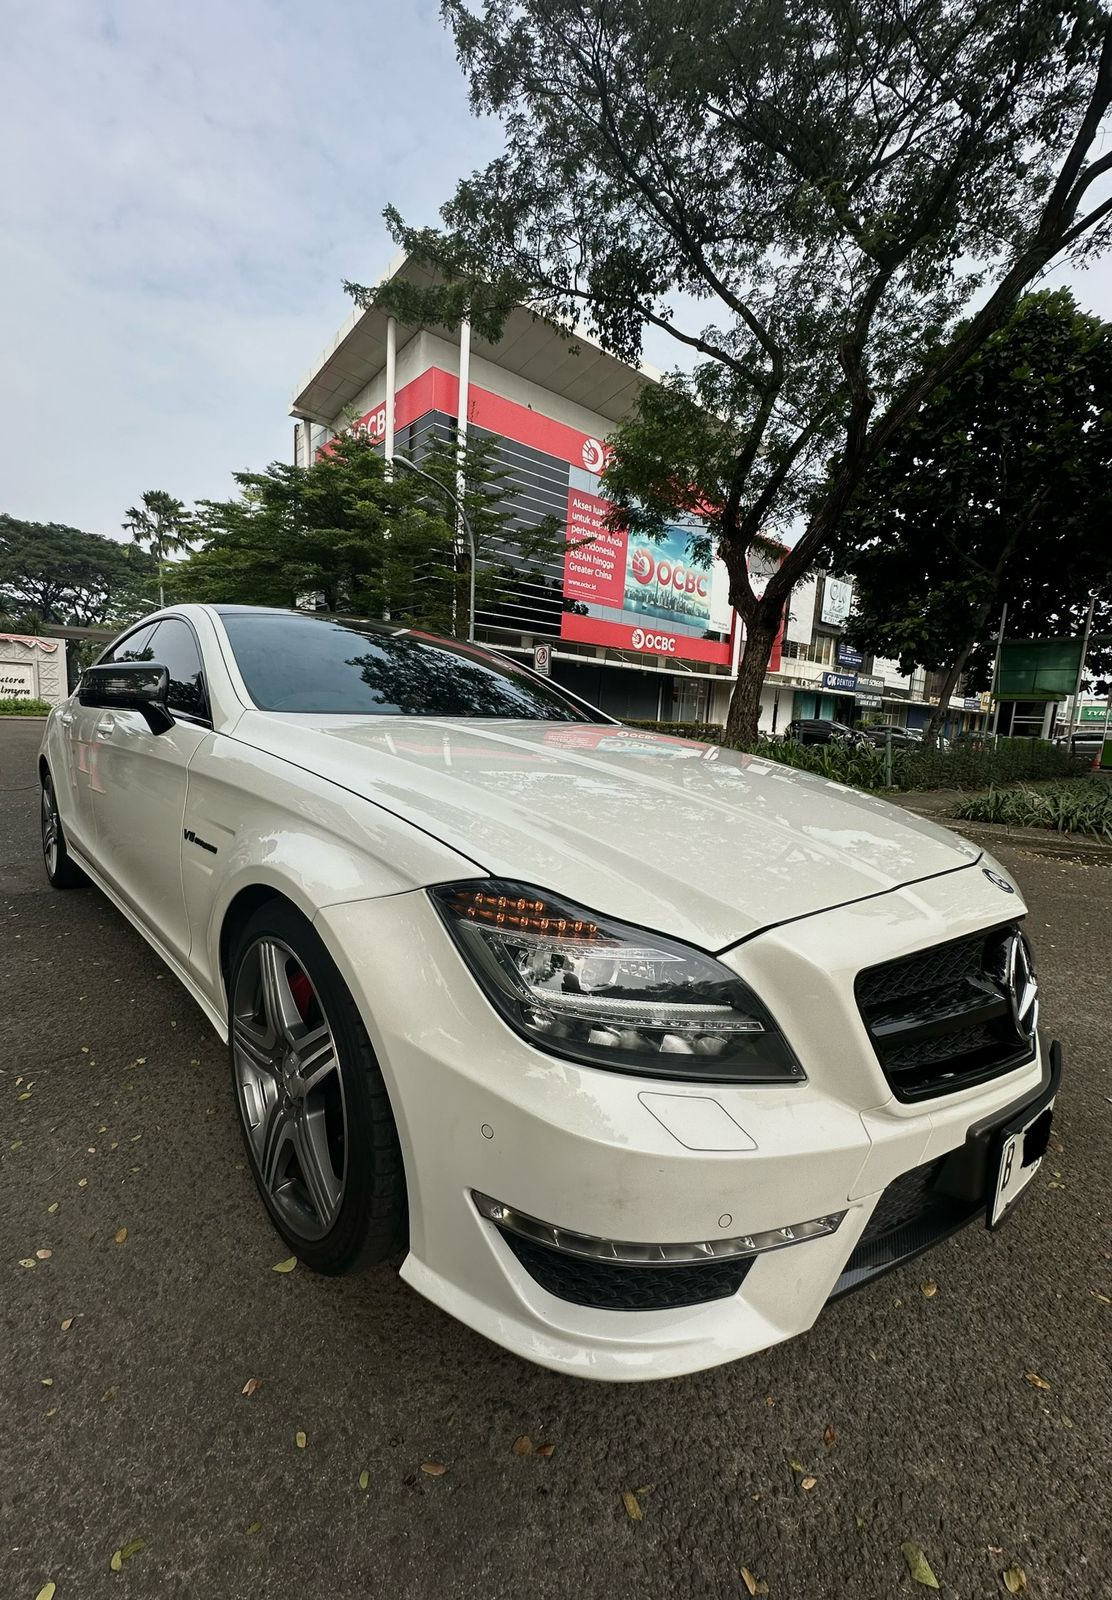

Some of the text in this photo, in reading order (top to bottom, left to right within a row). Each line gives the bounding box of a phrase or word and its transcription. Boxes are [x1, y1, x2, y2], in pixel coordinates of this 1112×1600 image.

[572, 498, 592, 512] Akses
[571, 512, 591, 525] untuk
[571, 525, 606, 541] perbankan
[606, 534, 623, 548] Anda
[569, 550, 614, 569] ASEAN hingga
[569, 562, 612, 580] Greater China
[656, 561, 708, 597] OCBC
[645, 633, 676, 652] OCBC
[827, 674, 855, 688] OK DENTIST
[1000, 1141, 1015, 1192] B
